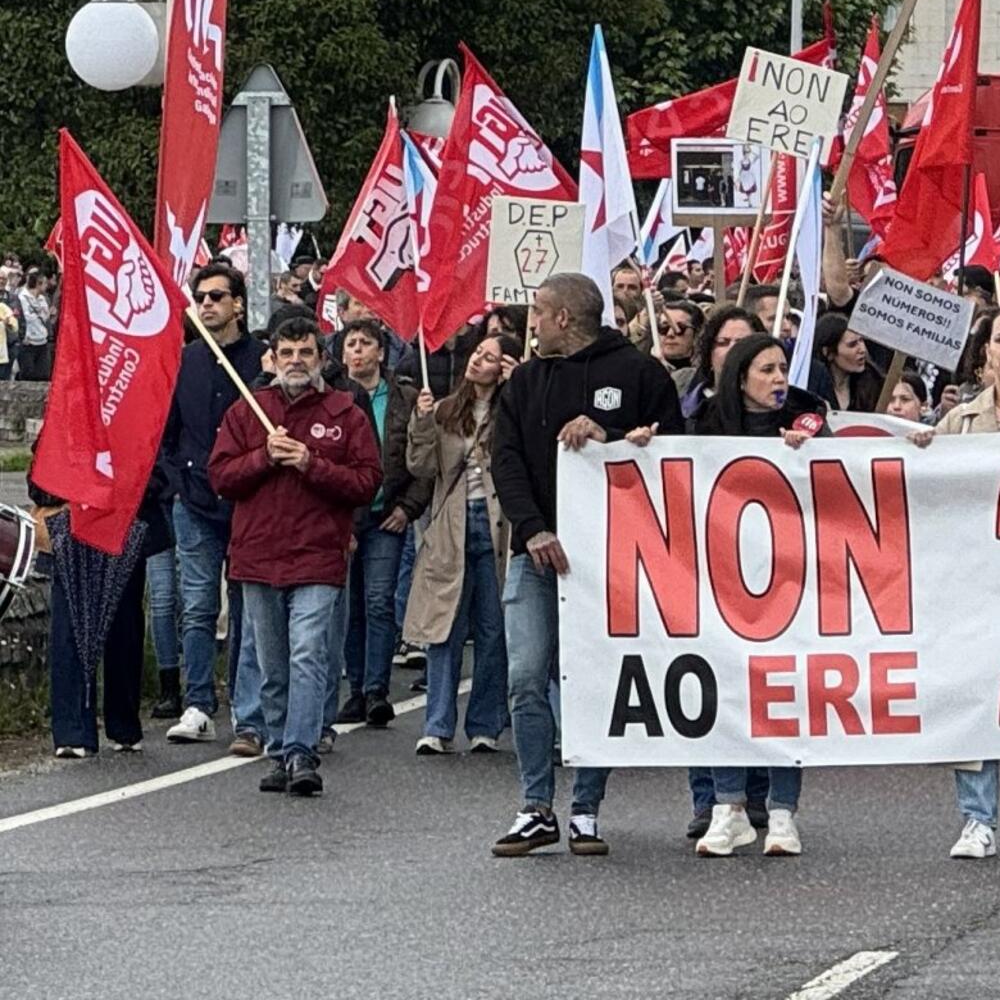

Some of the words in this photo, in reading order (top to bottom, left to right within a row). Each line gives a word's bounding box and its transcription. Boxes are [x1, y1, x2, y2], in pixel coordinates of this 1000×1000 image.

[767, 100, 808, 125] AO
[747, 117, 824, 157] ERE
[521, 247, 548, 274] 27
[884, 276, 913, 295] NON
[914, 289, 961, 314] SOMOS
[858, 303, 904, 329] SOMOS
[906, 322, 962, 351] FAMILIAS
[605, 456, 914, 643] NON
[607, 653, 719, 739] AO
[748, 651, 922, 739] ERE
